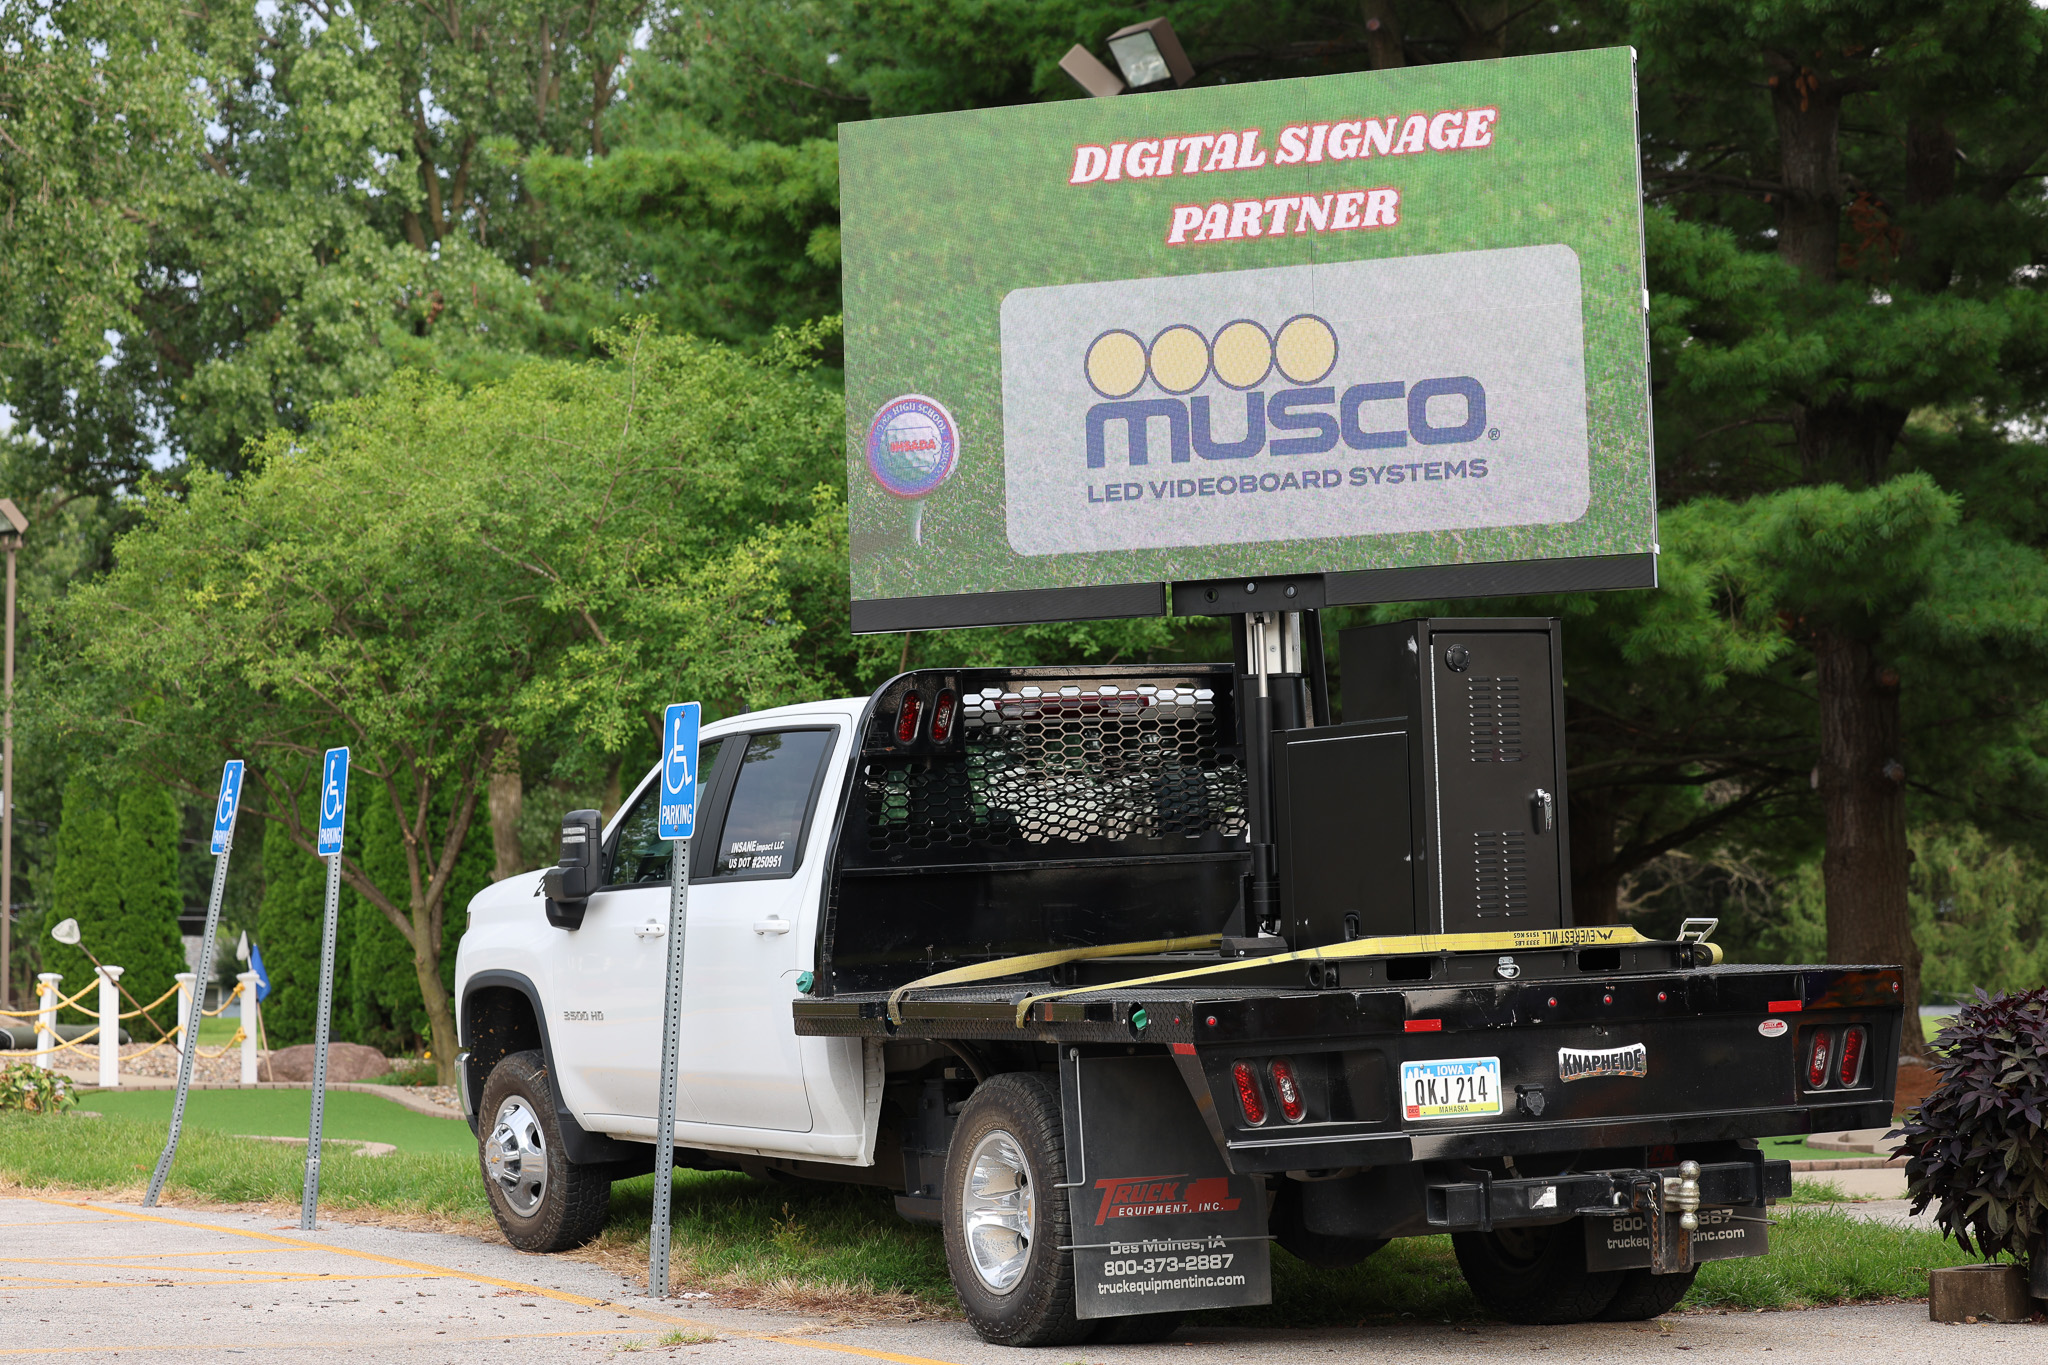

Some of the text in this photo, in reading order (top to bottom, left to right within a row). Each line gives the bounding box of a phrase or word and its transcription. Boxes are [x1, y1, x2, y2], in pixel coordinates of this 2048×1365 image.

[1069, 107, 1498, 184] DIGITAL SIGNAGE
[1167, 188, 1400, 244] PARTNER
[918, 404, 947, 434] SCHOOL
[1088, 458, 1489, 503] LED VIDEOBOARD SYSTEMS
[661, 803, 693, 826] PARKING
[320, 827, 342, 845] PARKING
[731, 840, 785, 854] INSANE impact LLC
[729, 855, 783, 869] US DOT #250951
[1542, 929, 1596, 945] EVEREST WLL
[563, 1011, 605, 1021] 3500 HD
[1437, 1065, 1466, 1076] IOWA
[1562, 1048, 1644, 1077] KNAPHEIDE
[1415, 1076, 1488, 1106] QKJ 214
[1439, 1105, 1469, 1114] MAHASKA
[1094, 1173, 1189, 1226] TRUCK
[1118, 1201, 1225, 1217] EQUIPMENT, INC.
[1110, 1241, 1140, 1255] Des
[1207, 1234, 1227, 1249] IA
[1104, 1253, 1234, 1277] 800-373-2887
[1097, 1274, 1246, 1295] truckequipmentinc.com
